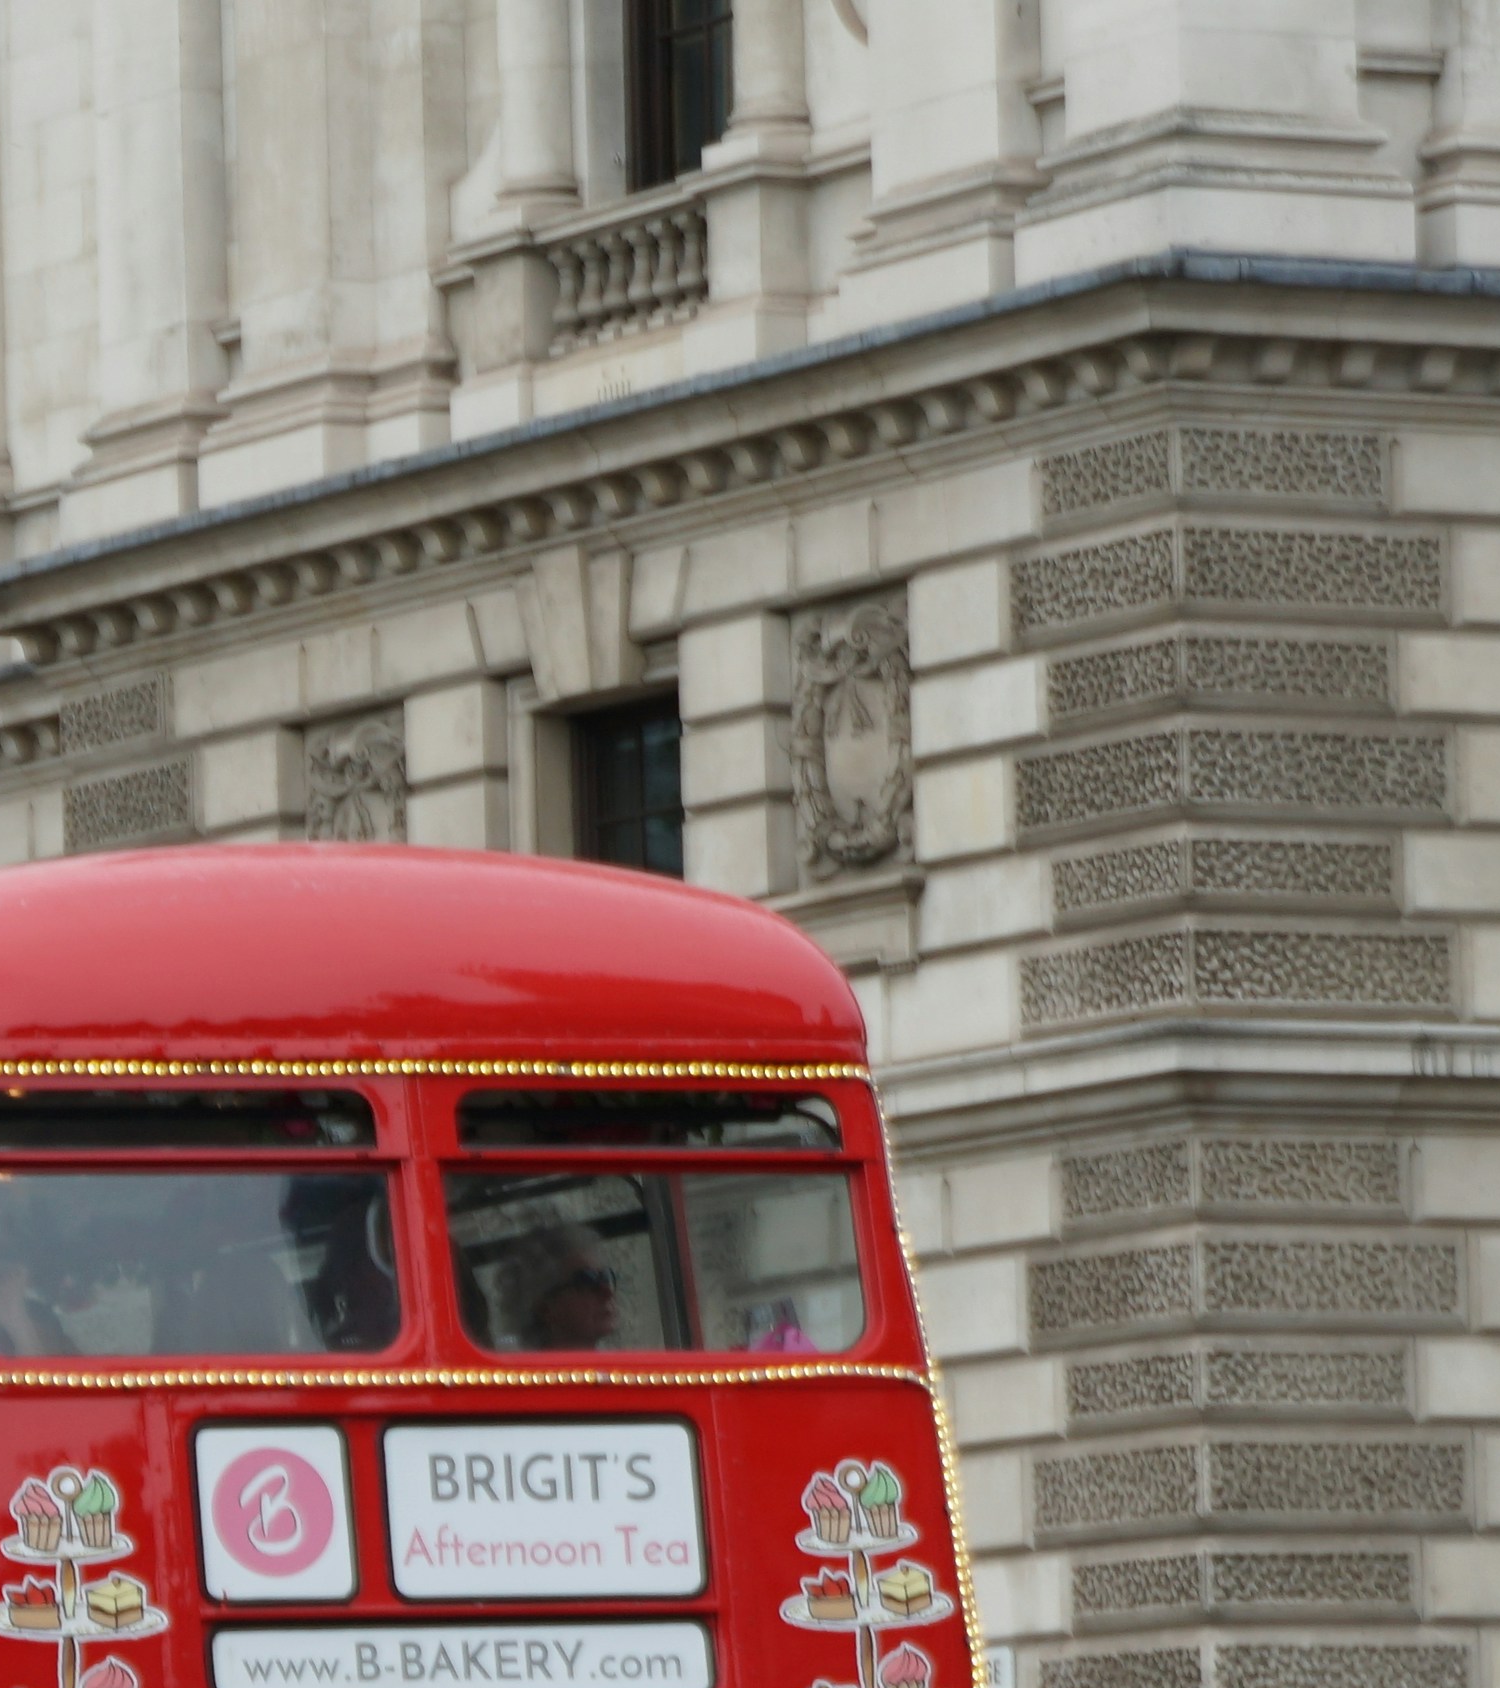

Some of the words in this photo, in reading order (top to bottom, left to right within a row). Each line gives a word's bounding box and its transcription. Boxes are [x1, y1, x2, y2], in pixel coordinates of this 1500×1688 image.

[428, 1453, 657, 1502] BRIGIT'S
[403, 1526, 601, 1567] Afternoon
[615, 1525, 690, 1566] Tea
[242, 1640, 682, 1684] www.B-BAKERY.com
